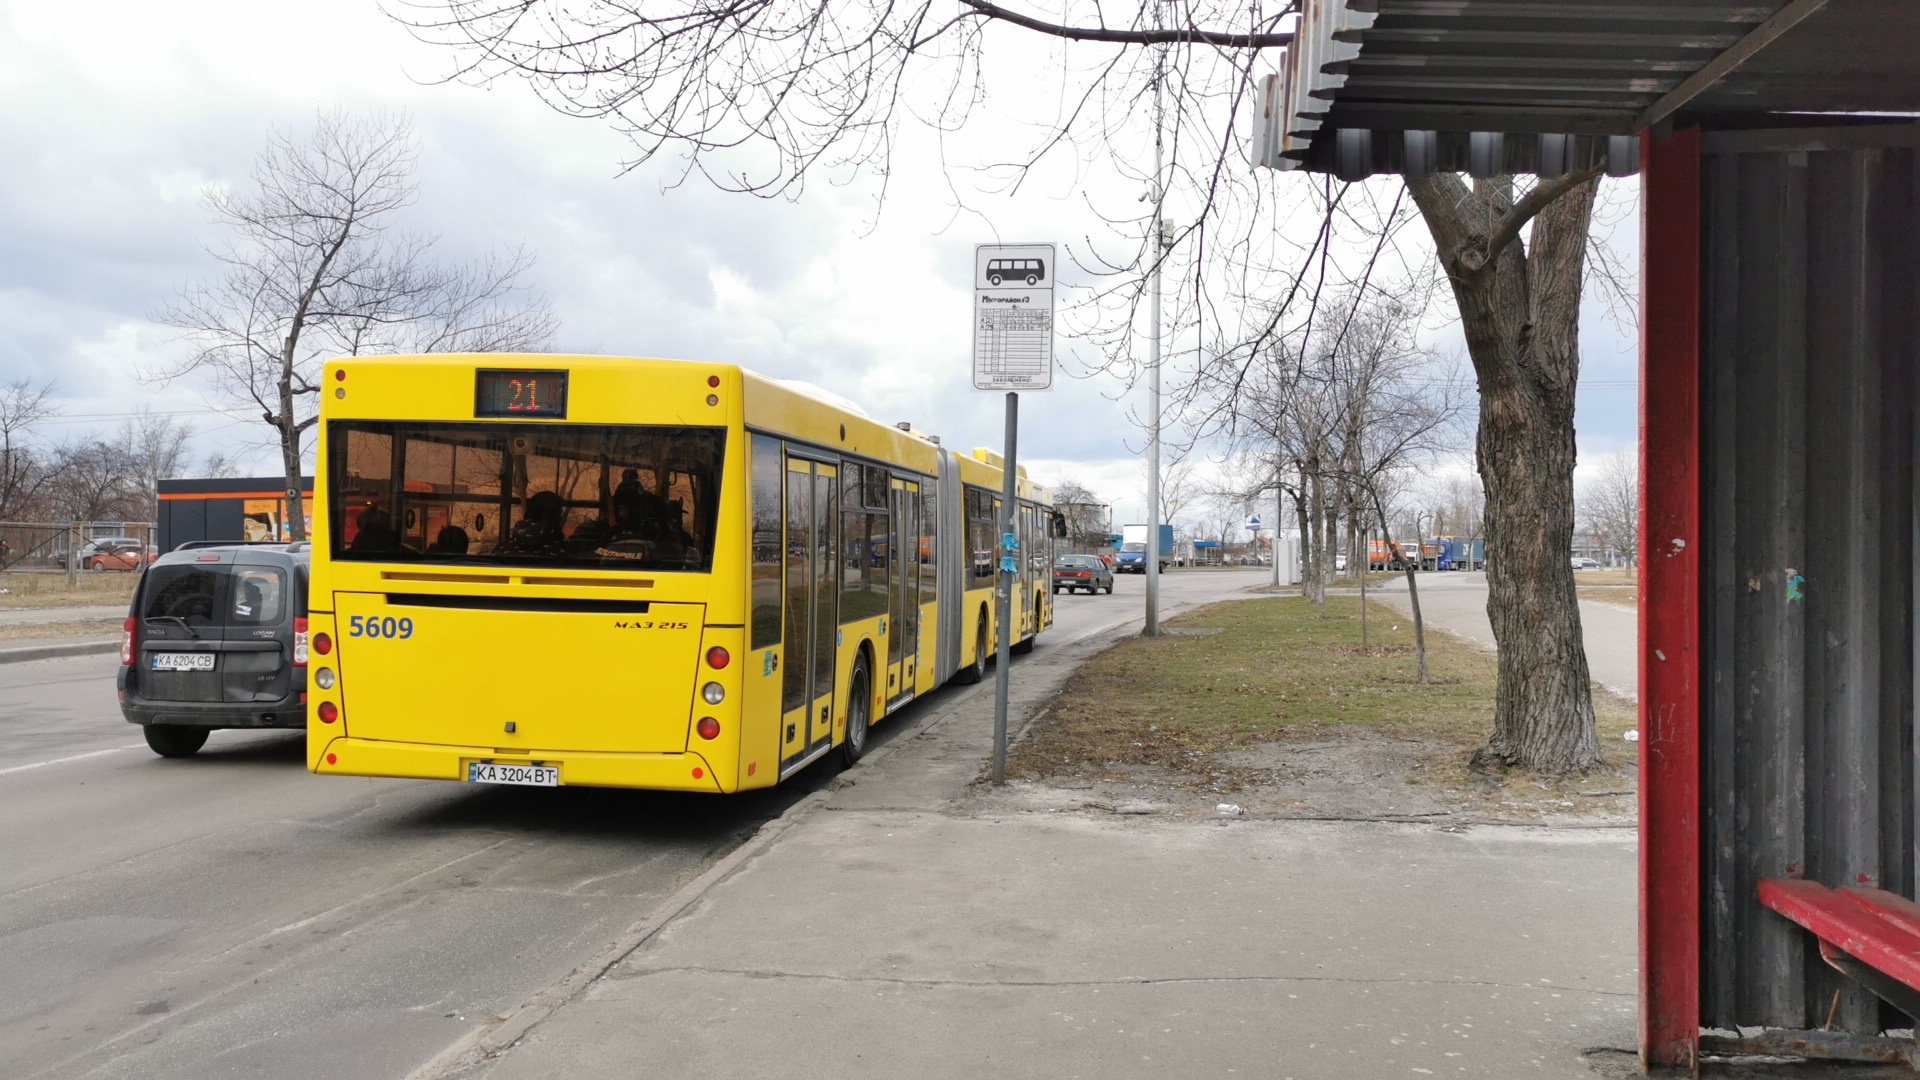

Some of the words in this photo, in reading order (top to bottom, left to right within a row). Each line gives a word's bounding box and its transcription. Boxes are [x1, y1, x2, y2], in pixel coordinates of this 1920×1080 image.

[508, 379, 540, 410] 21
[594, 547, 643, 560] SOUTHPOLE
[349, 615, 413, 640] 5609
[658, 621, 689, 630] 215
[173, 655, 195, 667] 6204
[500, 767, 532, 783] 3204
